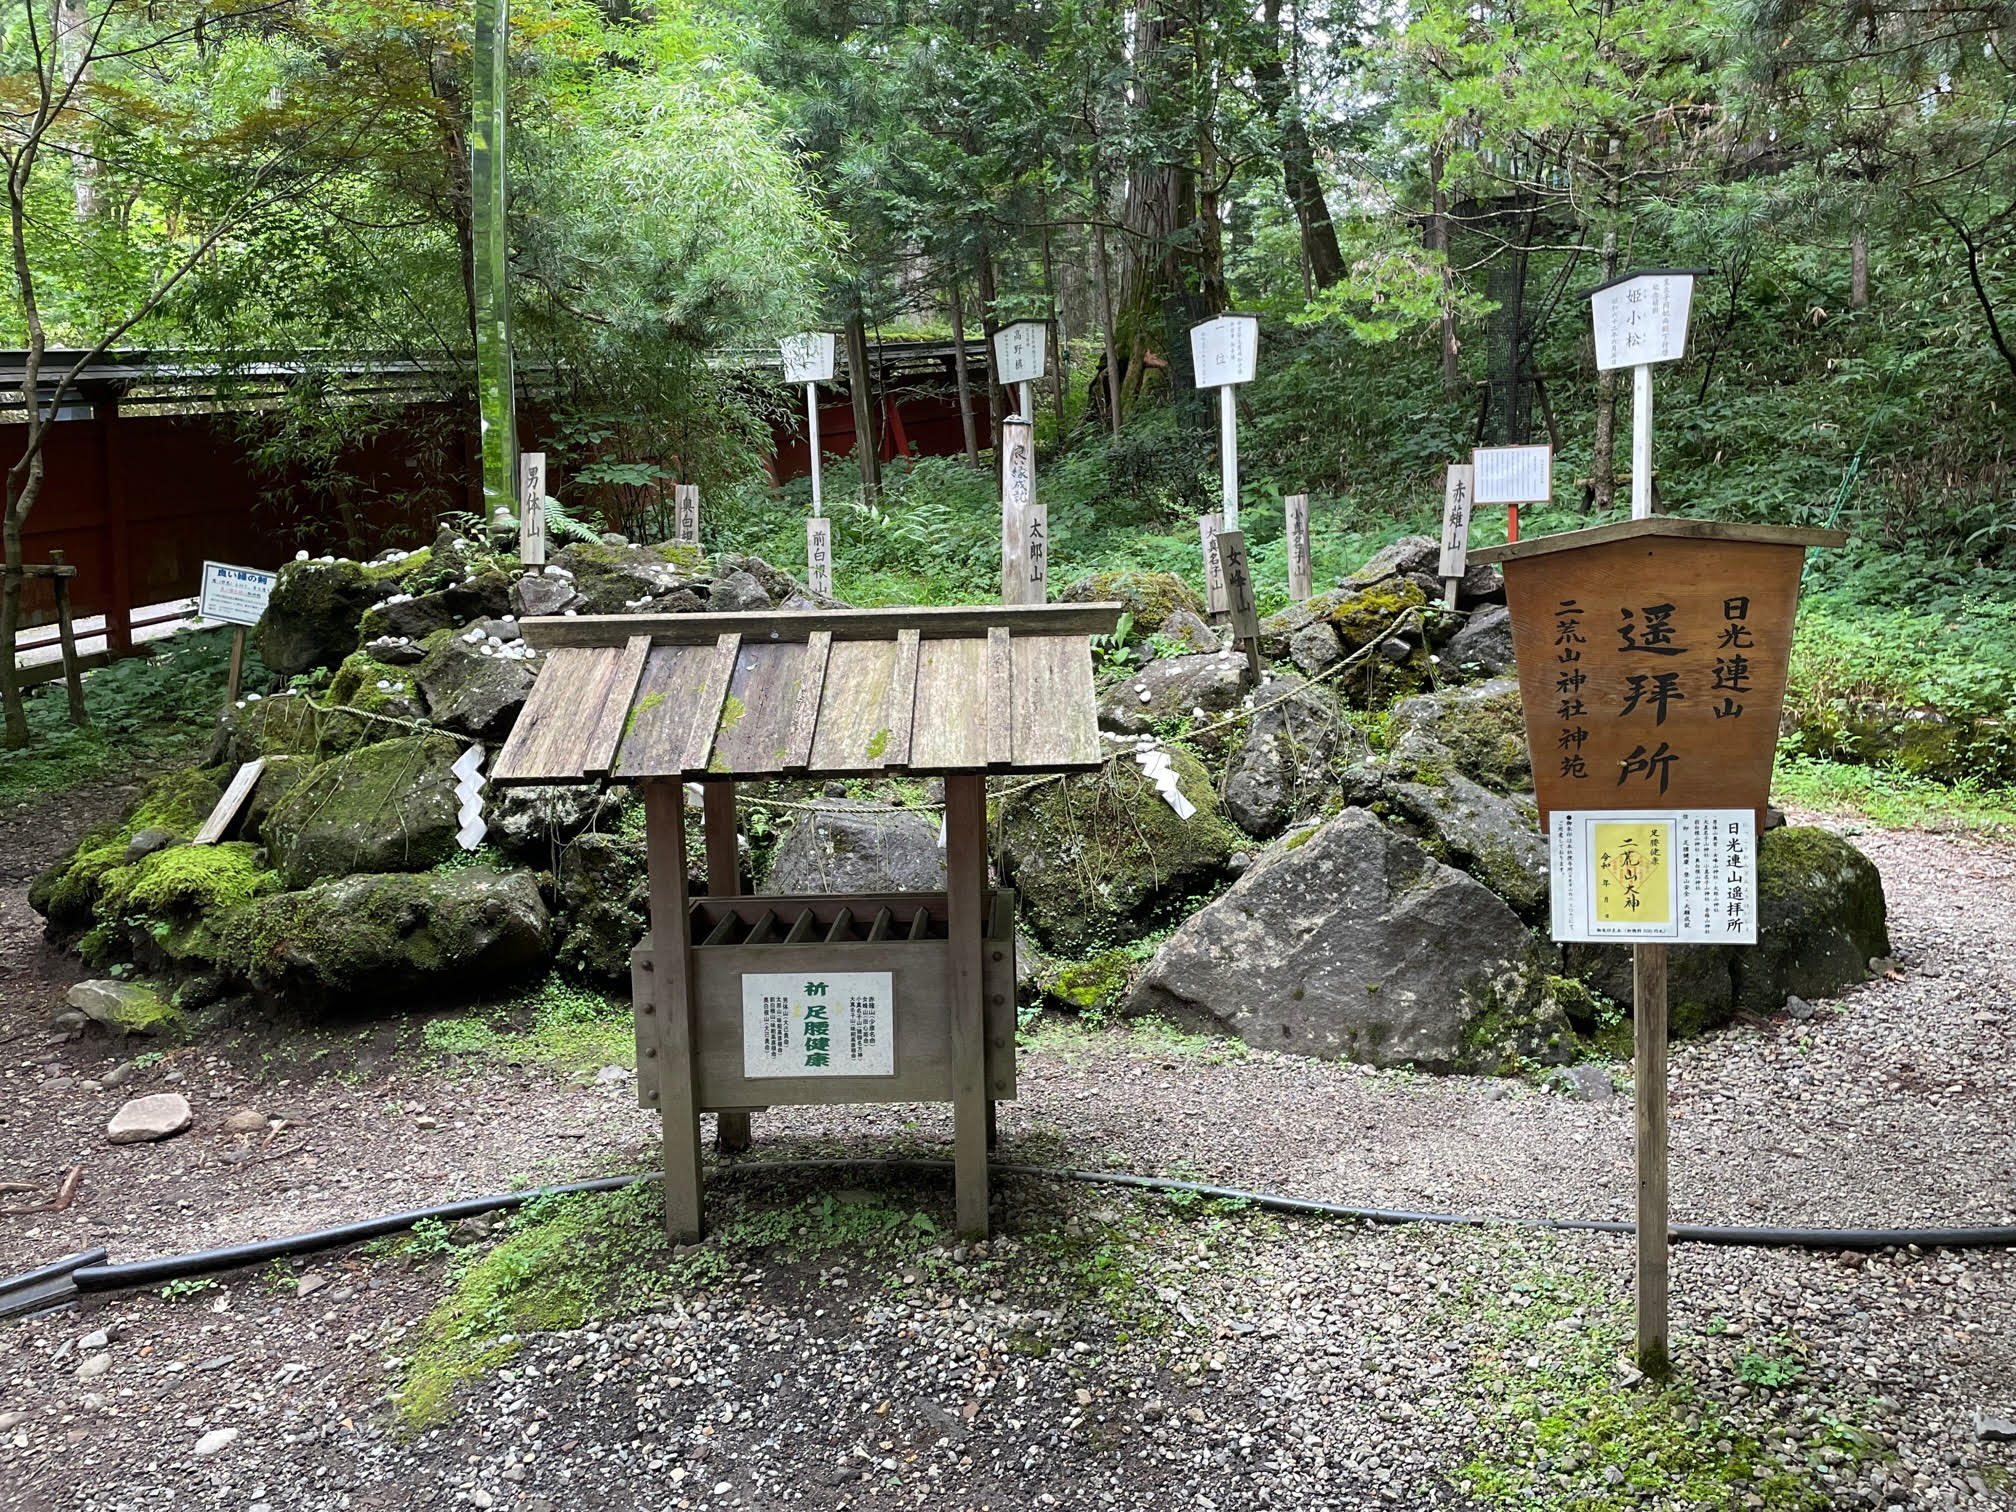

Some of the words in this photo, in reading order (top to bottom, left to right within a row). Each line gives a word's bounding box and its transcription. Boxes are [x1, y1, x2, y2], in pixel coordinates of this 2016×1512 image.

[1626, 288, 1642, 348] 姫小松
[526, 466, 541, 538] 男体山
[1448, 479, 1466, 551] 赤薙山
[812, 530, 828, 594] 前白根山
[1029, 517, 1043, 583] 太郎山
[1207, 526, 1223, 591] 大真名子山
[1227, 545, 1247, 613] 女峰山
[1554, 600, 1589, 779] 二荒山神社神苑
[1710, 596, 1754, 719] 日光連山
[1617, 602, 1688, 797] 遥拝所
[1601, 852, 1611, 869] 令和
[1618, 838, 1640, 912] 二荒山大神
[1726, 822, 1744, 933] 日光連山遥拝所
[803, 981, 829, 997] 祈
[803, 1005, 831, 1067] 足腰健康
